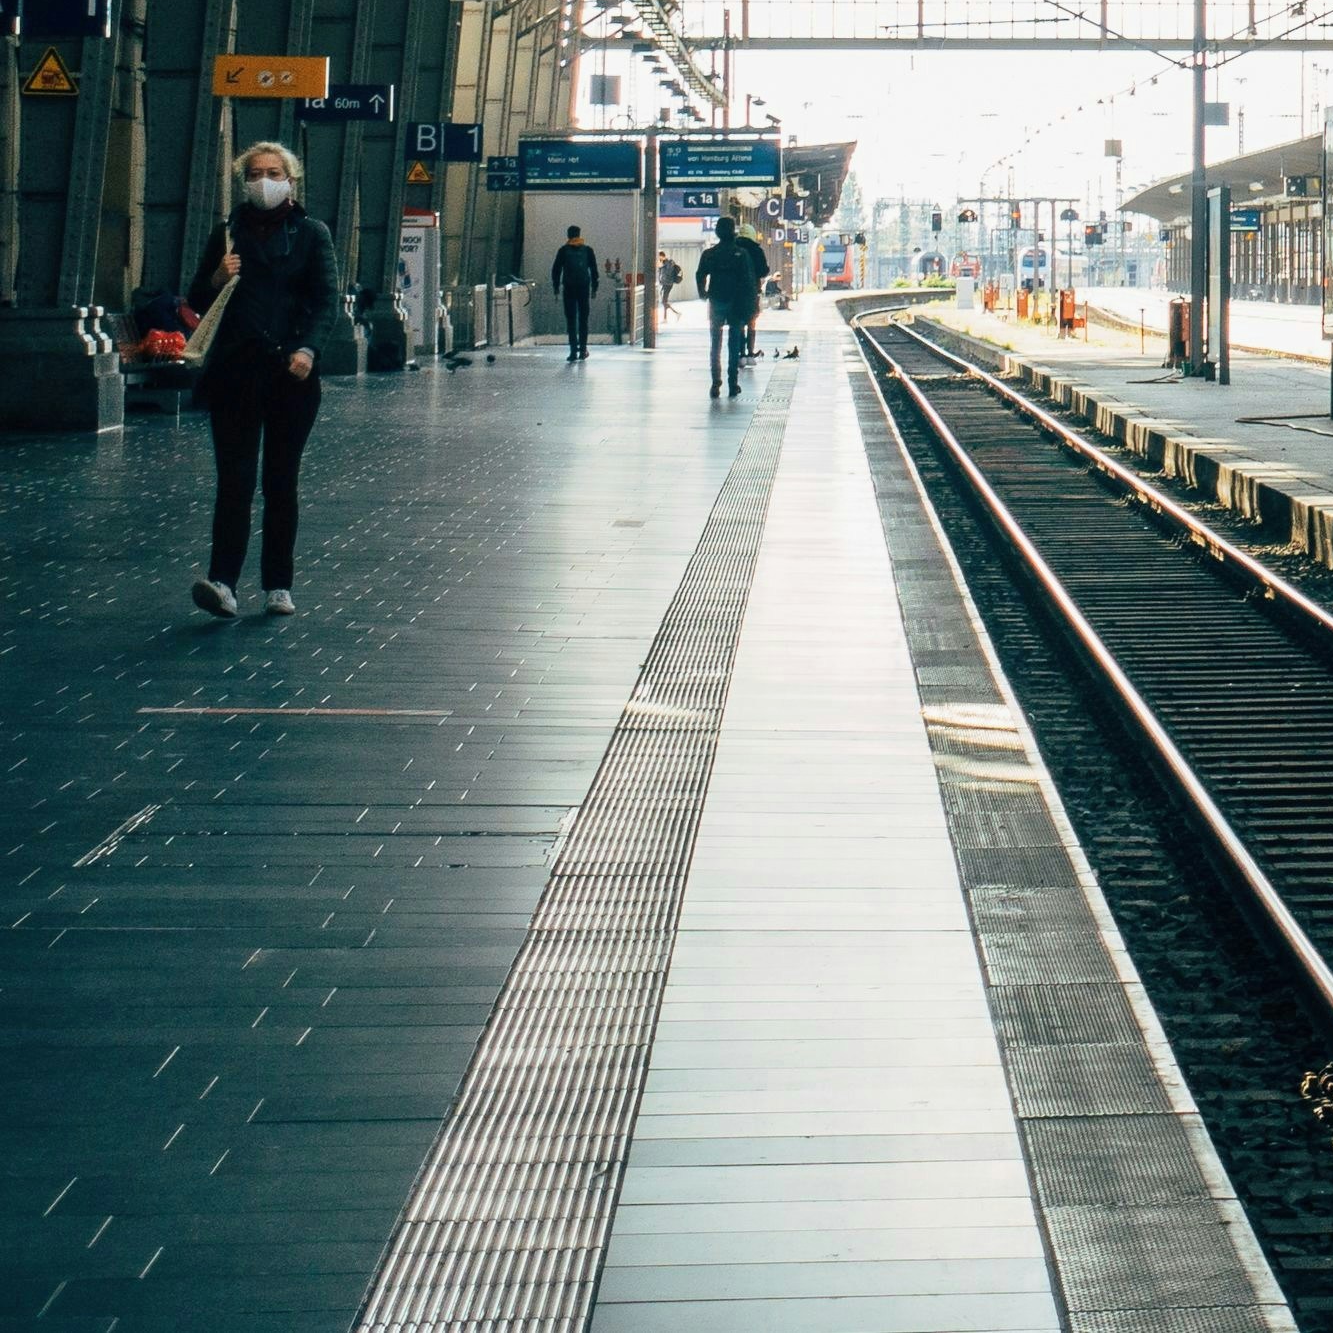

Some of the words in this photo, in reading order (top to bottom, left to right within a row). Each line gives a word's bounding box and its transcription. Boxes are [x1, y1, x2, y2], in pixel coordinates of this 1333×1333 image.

[334, 97, 360, 110] 60m
[416, 124, 436, 152] B
[467, 126, 479, 153] 1
[504, 157, 516, 168] 1a
[701, 193, 713, 204] 1a
[766, 198, 780, 217] C
[795, 200, 804, 217] 1
[776, 229, 785, 242] D
